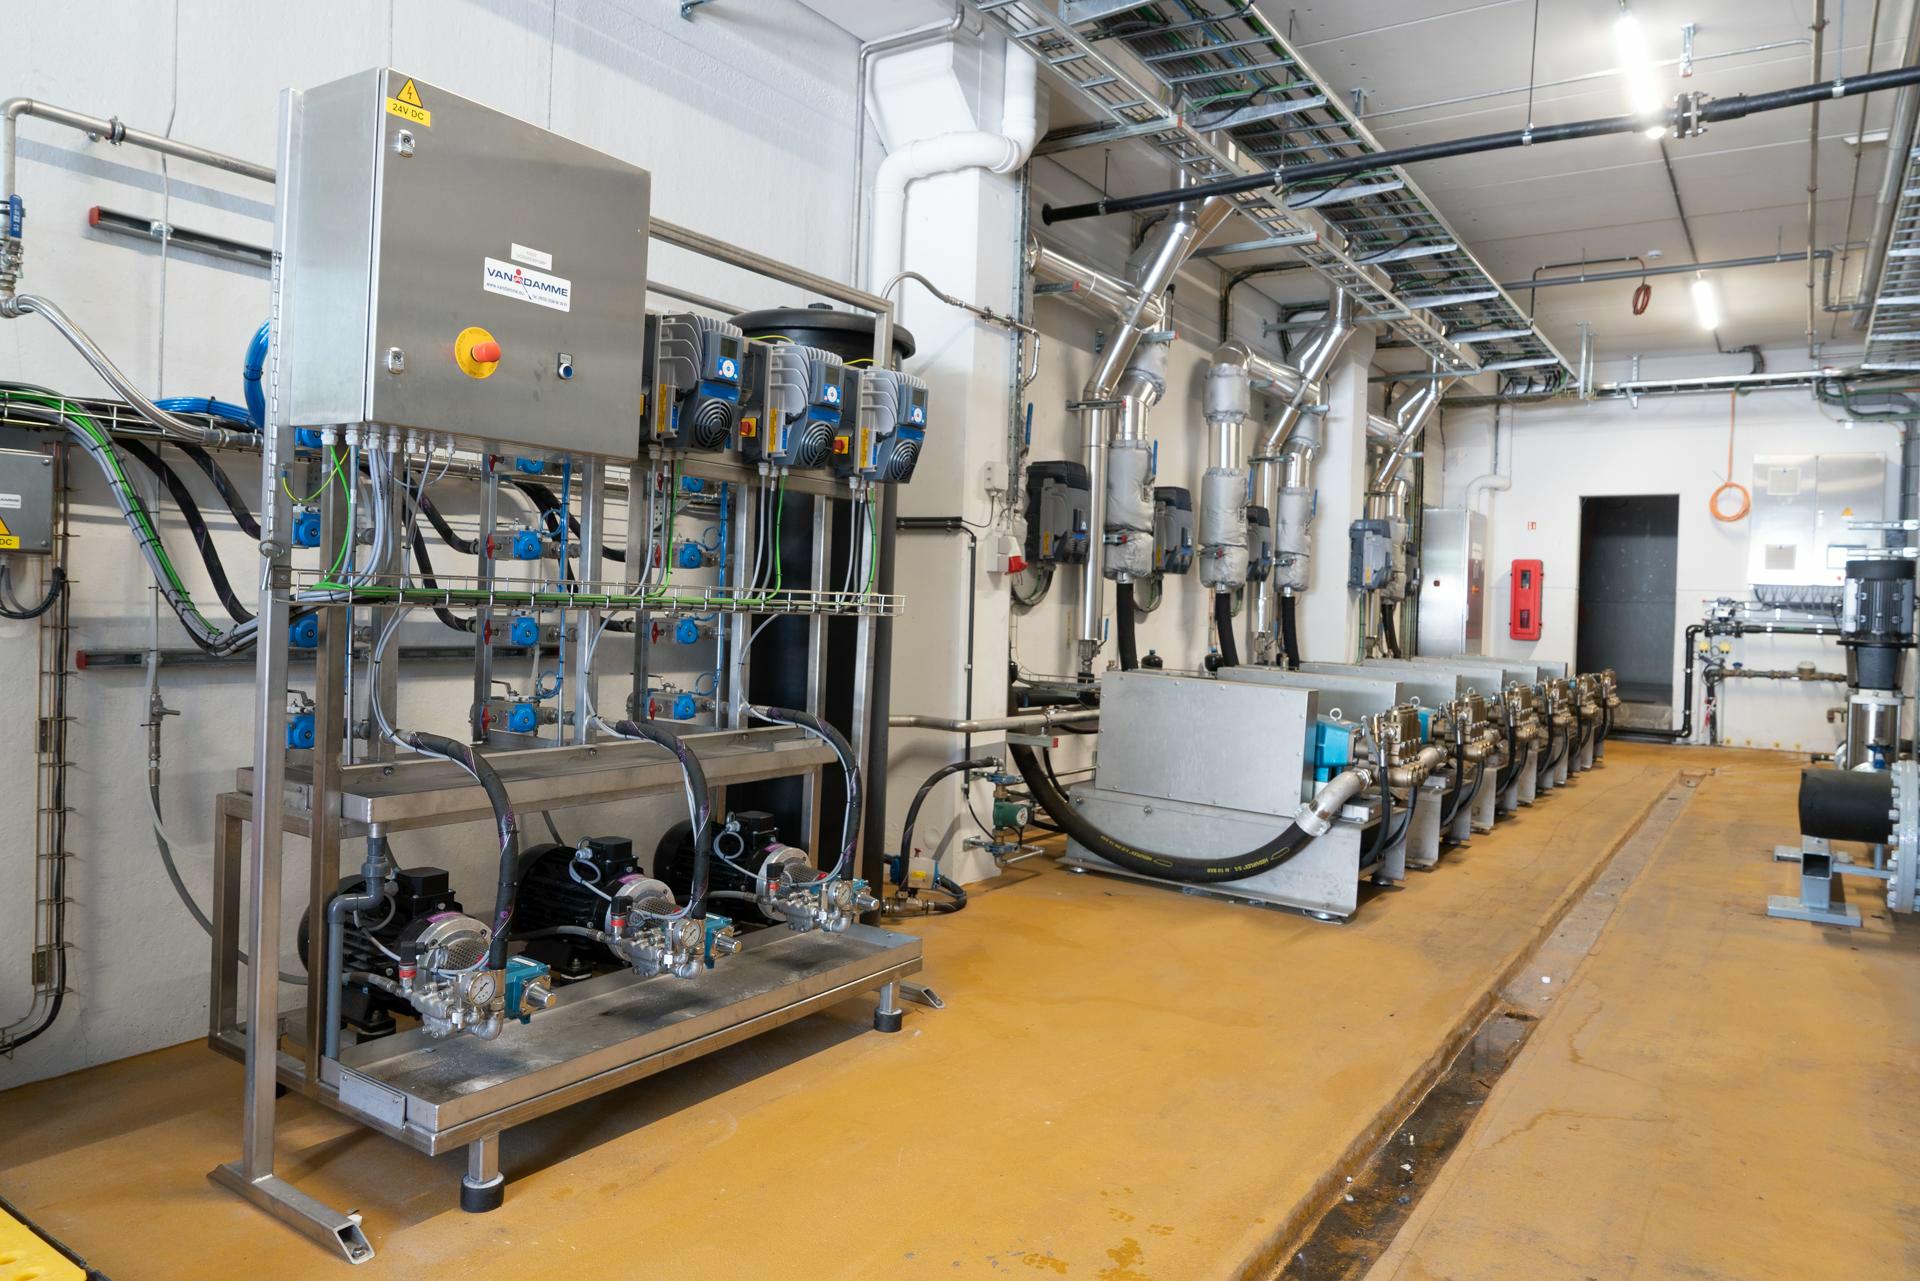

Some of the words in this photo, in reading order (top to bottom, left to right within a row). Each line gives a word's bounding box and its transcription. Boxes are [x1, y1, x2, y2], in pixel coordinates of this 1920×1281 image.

[392, 103, 409, 115] 24V
[411, 109, 424, 121] DC
[487, 267, 513, 282] VAN
[523, 278, 569, 297] DAMME
